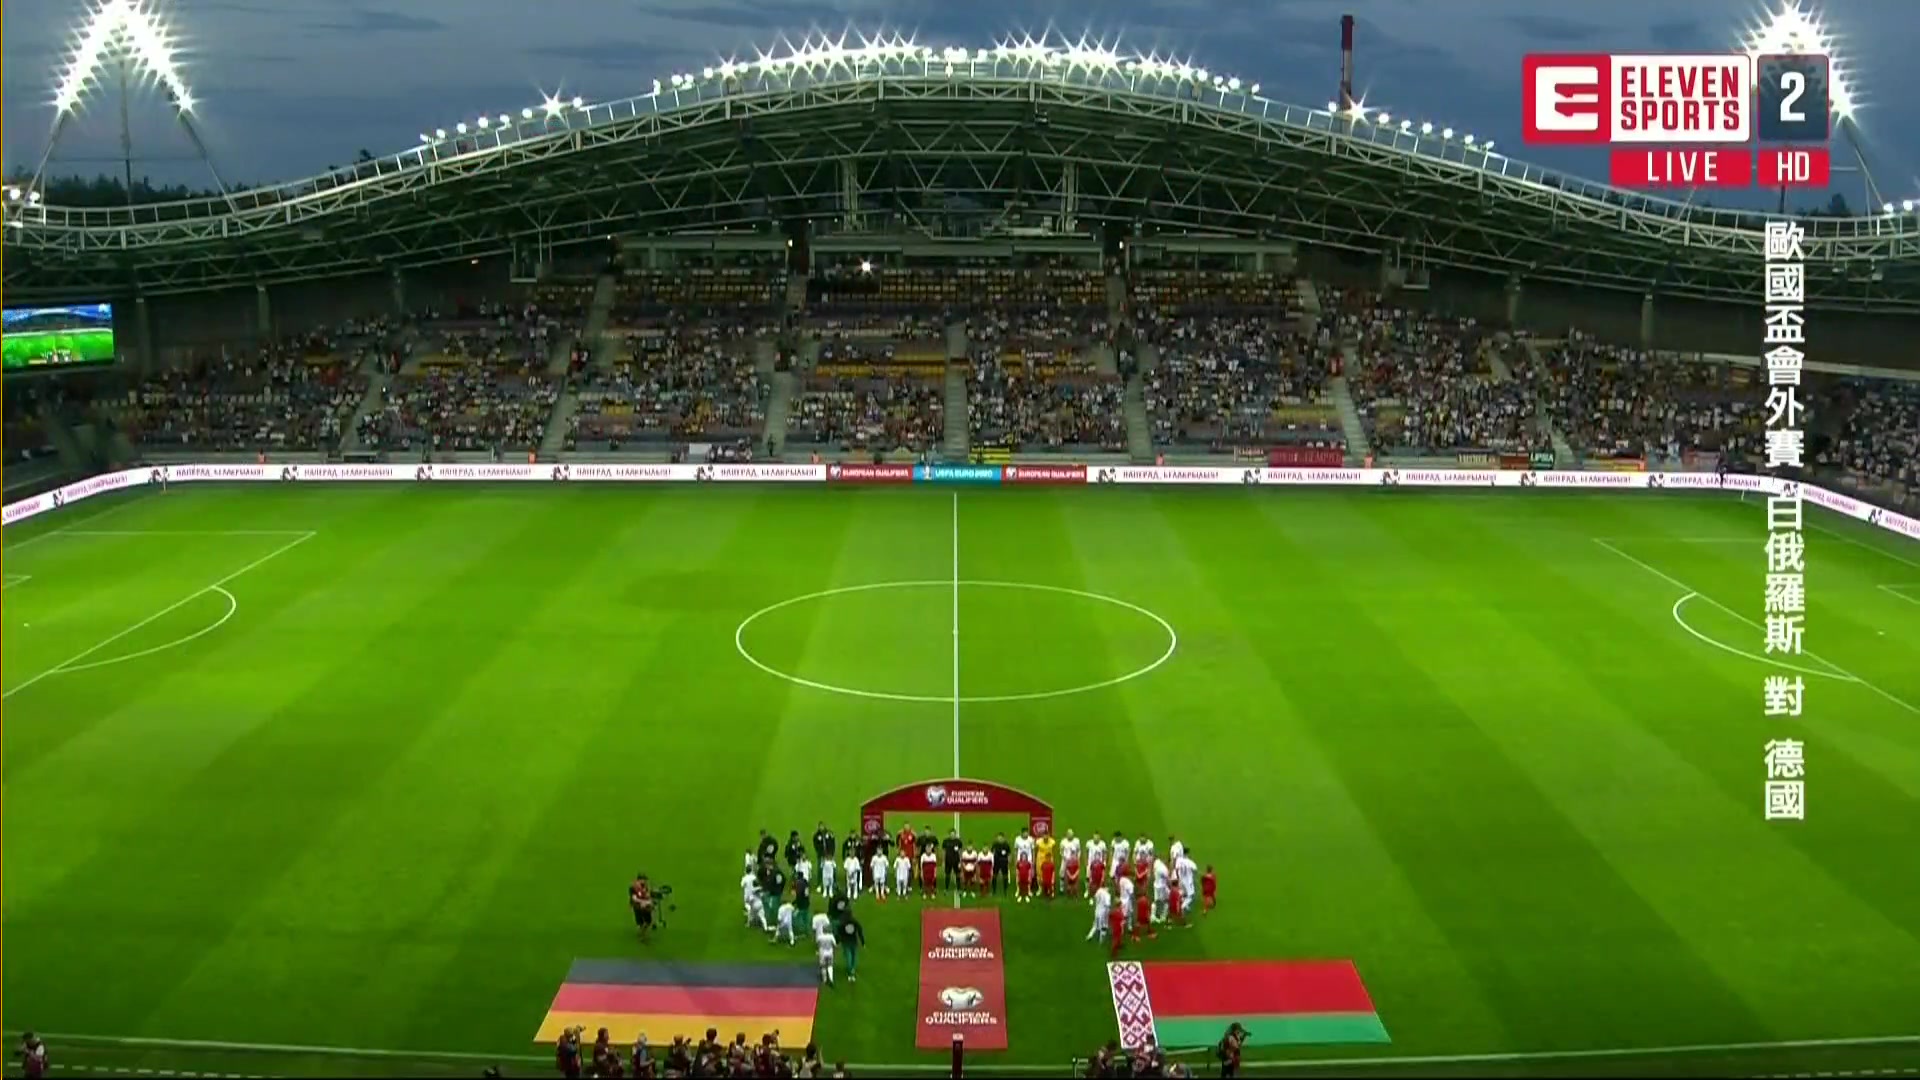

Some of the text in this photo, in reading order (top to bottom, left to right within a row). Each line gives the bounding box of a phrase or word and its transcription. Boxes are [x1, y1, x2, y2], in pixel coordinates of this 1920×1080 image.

[955, 469, 974, 478] EURO
[946, 796, 989, 805] QUALIFIERS
[928, 951, 994, 960] QUALIFIERS
[925, 1016, 997, 1026] QUALIFIERS
